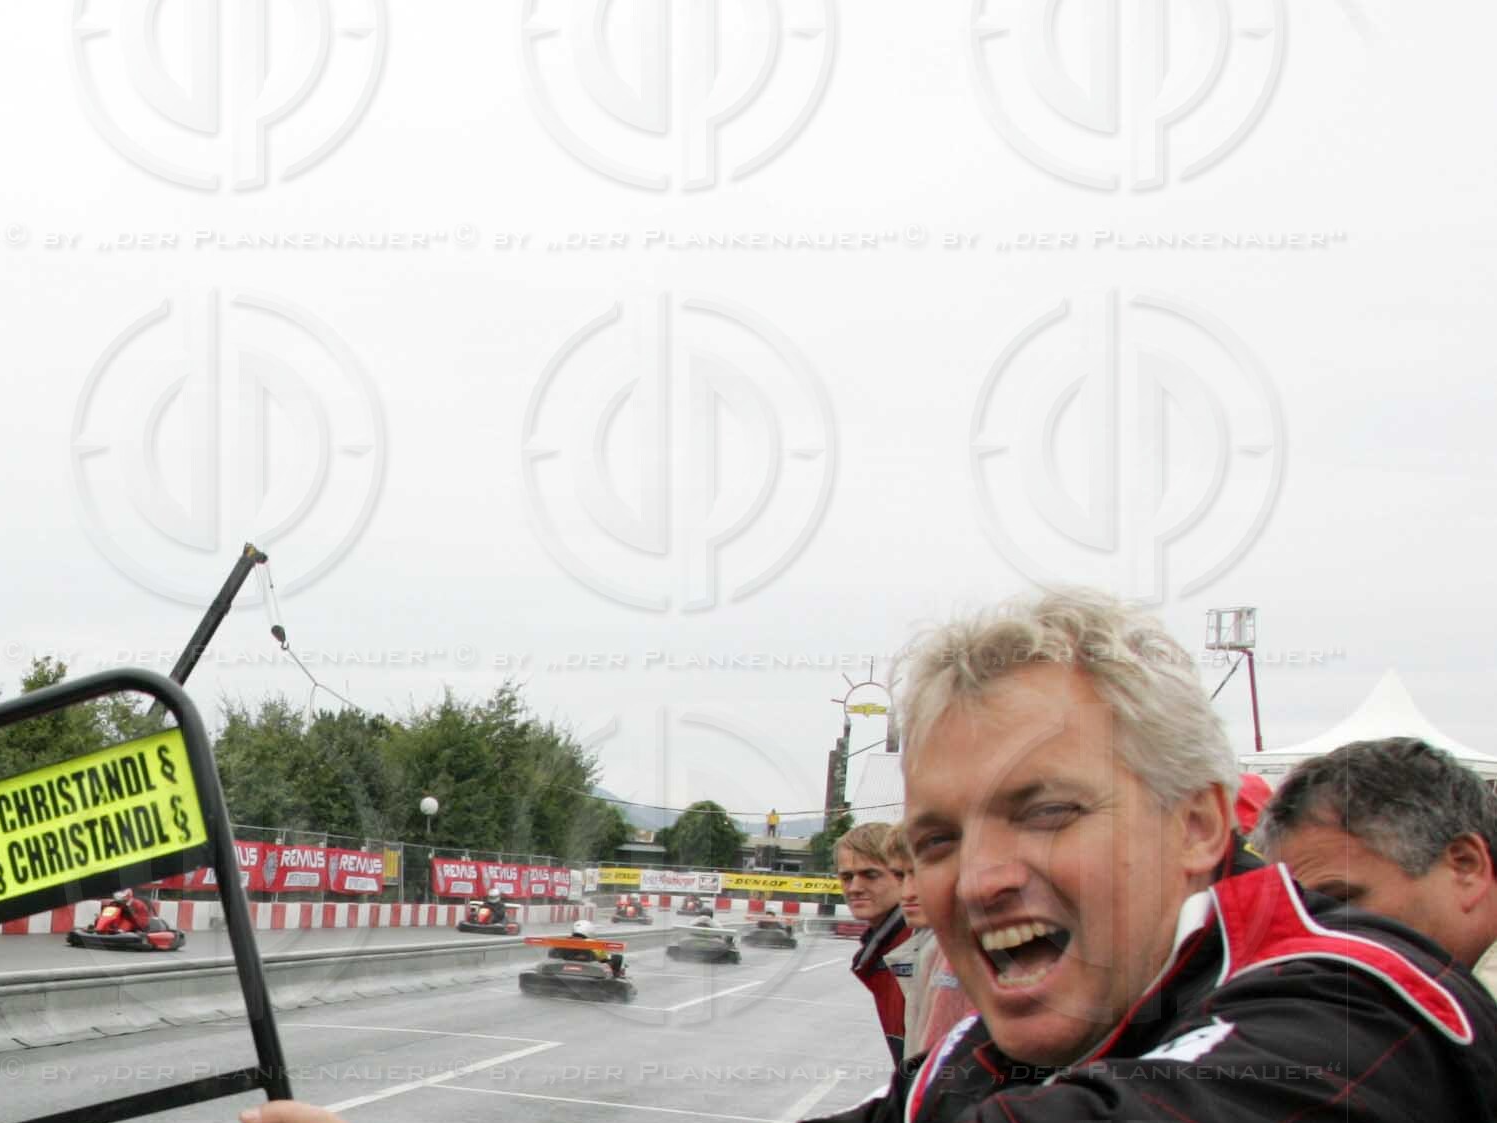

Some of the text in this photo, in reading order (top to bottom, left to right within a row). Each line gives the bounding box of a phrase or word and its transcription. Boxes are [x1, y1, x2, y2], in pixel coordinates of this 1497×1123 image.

[7, 801, 170, 885] CHRISTANDL
[280, 849, 326, 869] REMUS
[339, 853, 383, 874] REMUS
[733, 878, 788, 888] DUNLOP
